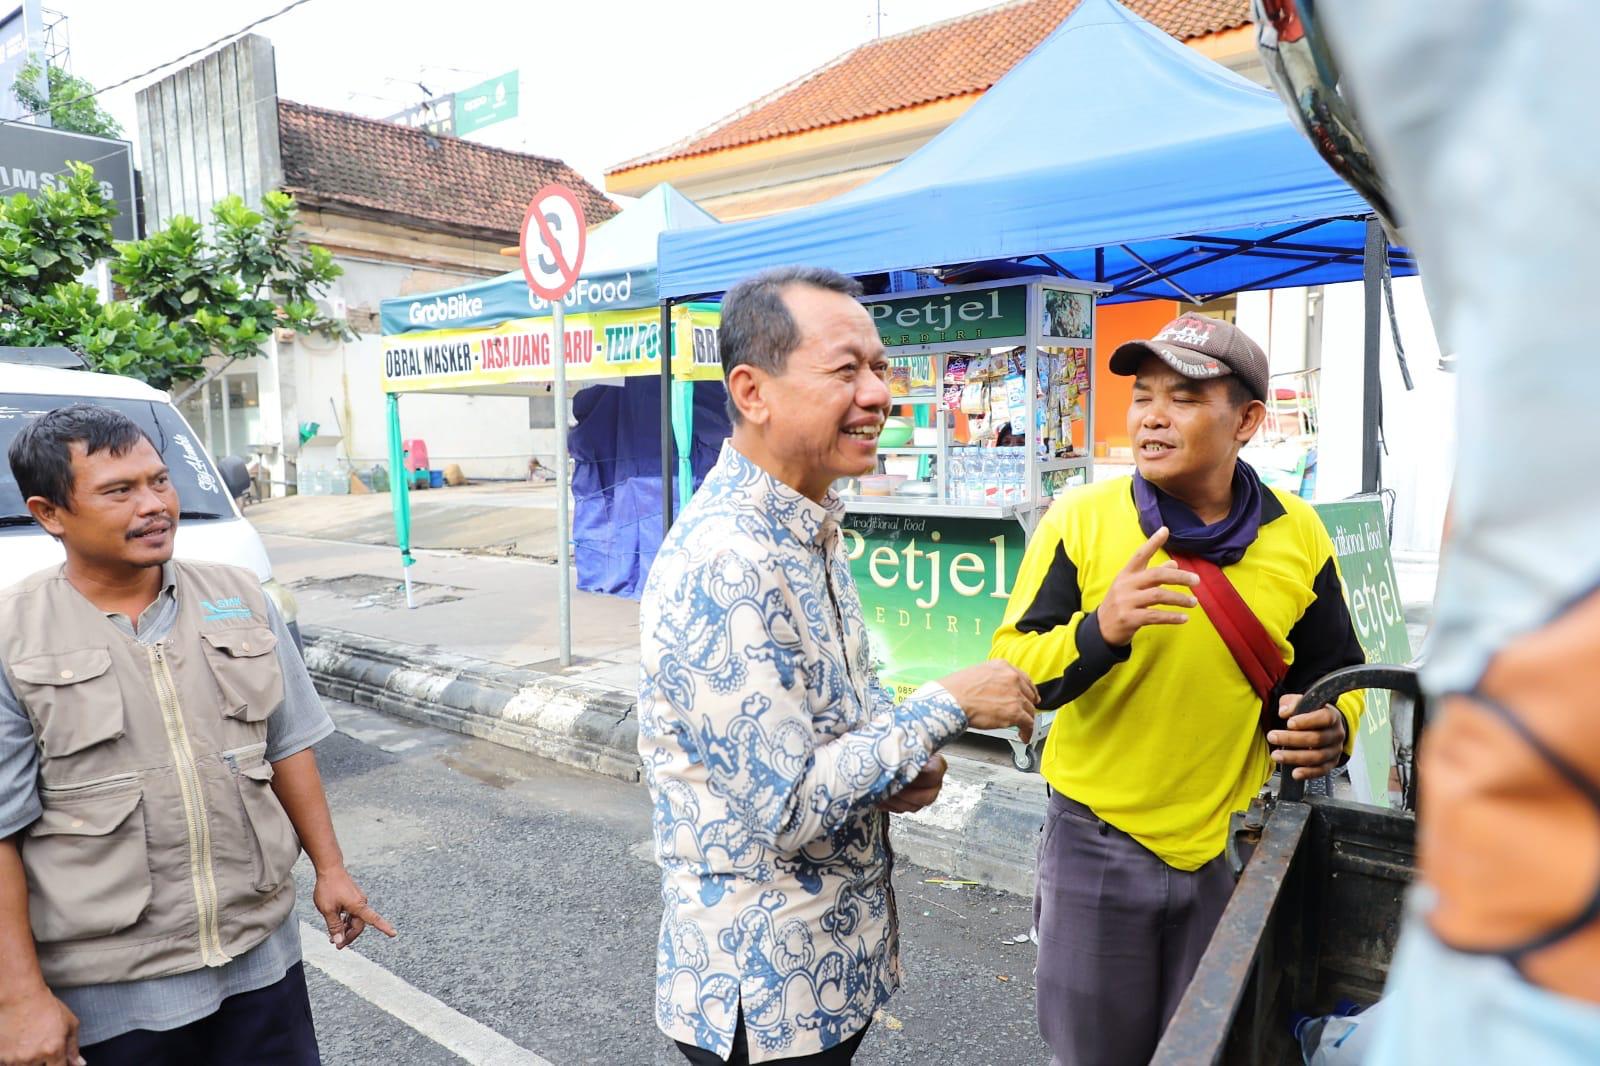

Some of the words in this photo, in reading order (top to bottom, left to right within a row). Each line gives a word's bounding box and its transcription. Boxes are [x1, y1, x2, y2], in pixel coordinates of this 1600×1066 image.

[409, 293, 483, 325] GrabBike
[528, 272, 632, 311] GFood
[866, 290, 1004, 332] Petjel
[385, 348, 422, 378] OBRAL
[424, 342, 472, 374] MASKER
[481, 336, 510, 370] JASA
[512, 332, 550, 367] UANG
[563, 329, 593, 364] ARU
[881, 329, 982, 345] KEDIRI
[876, 606, 982, 636] EDIRI
